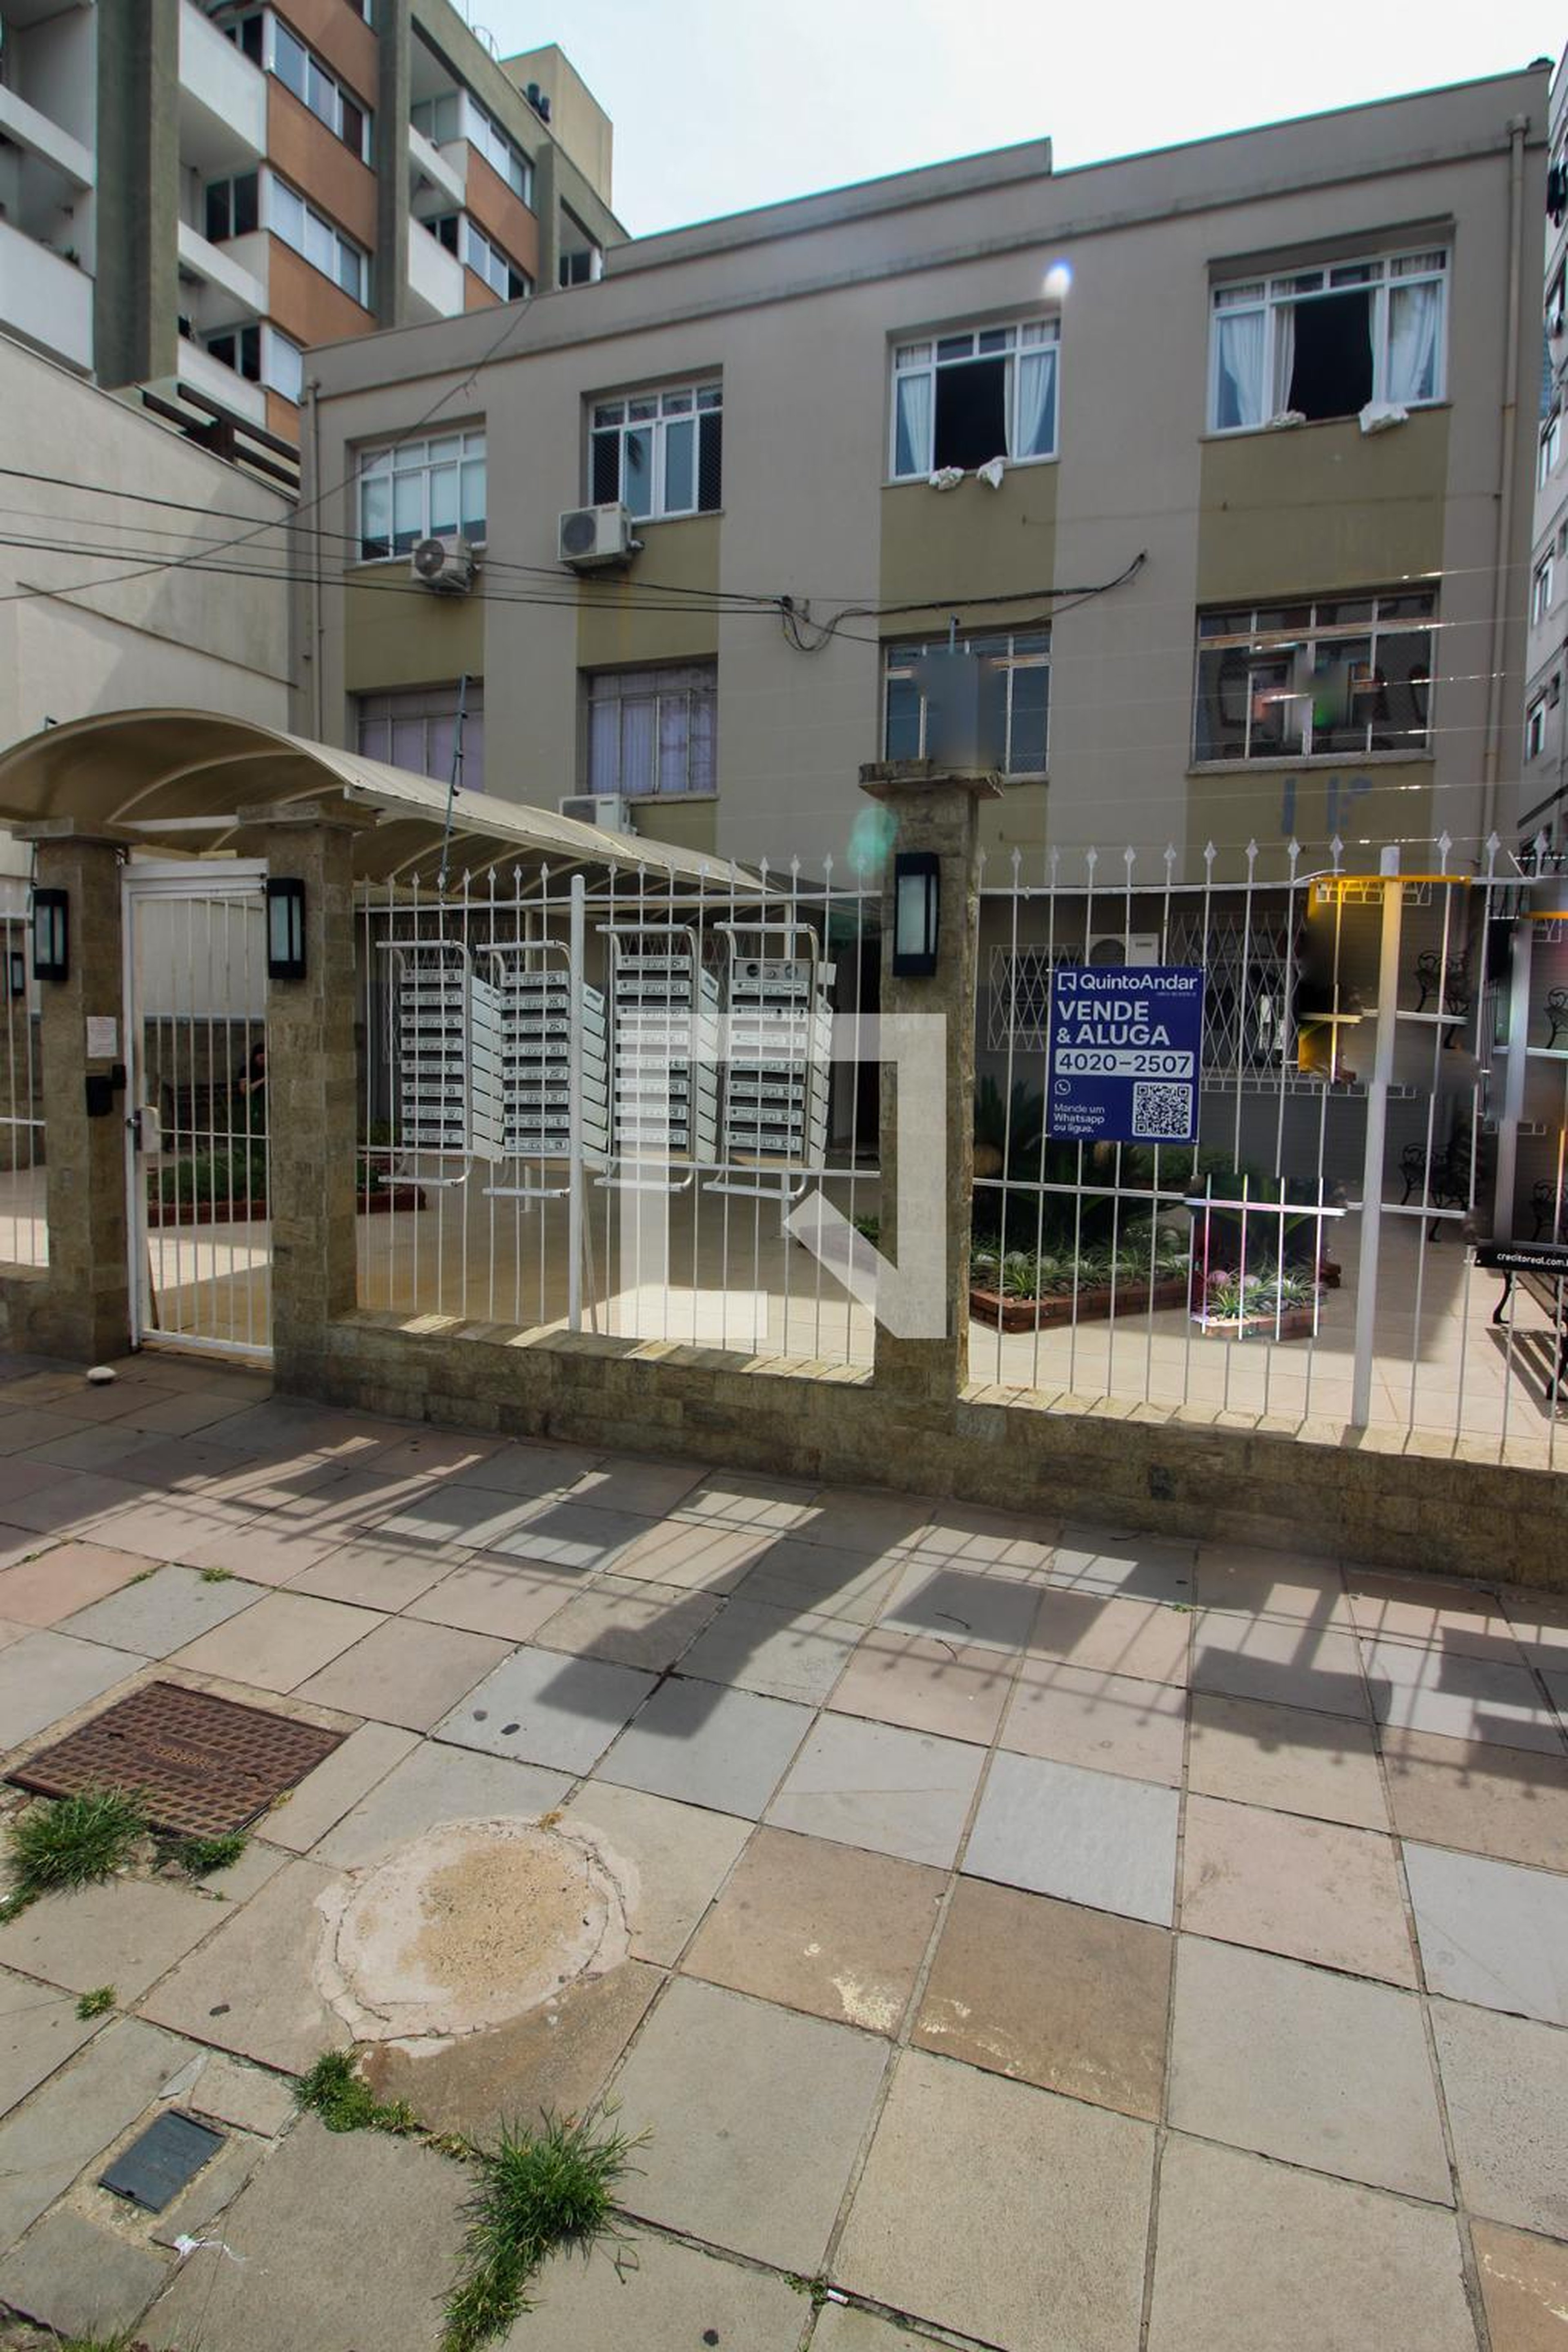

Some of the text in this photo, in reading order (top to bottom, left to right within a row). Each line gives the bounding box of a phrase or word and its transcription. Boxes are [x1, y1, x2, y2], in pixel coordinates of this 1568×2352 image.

[1080, 974, 1198, 990] QuintoAndar
[1058, 1001, 1149, 1021] VENDE
[1056, 1024, 1170, 1045] & ALUGA
[1059, 1053, 1190, 1074] 4020-2507
[1054, 1104, 1087, 1112] Mande
[1054, 1113, 1105, 1125] Whatsapp
